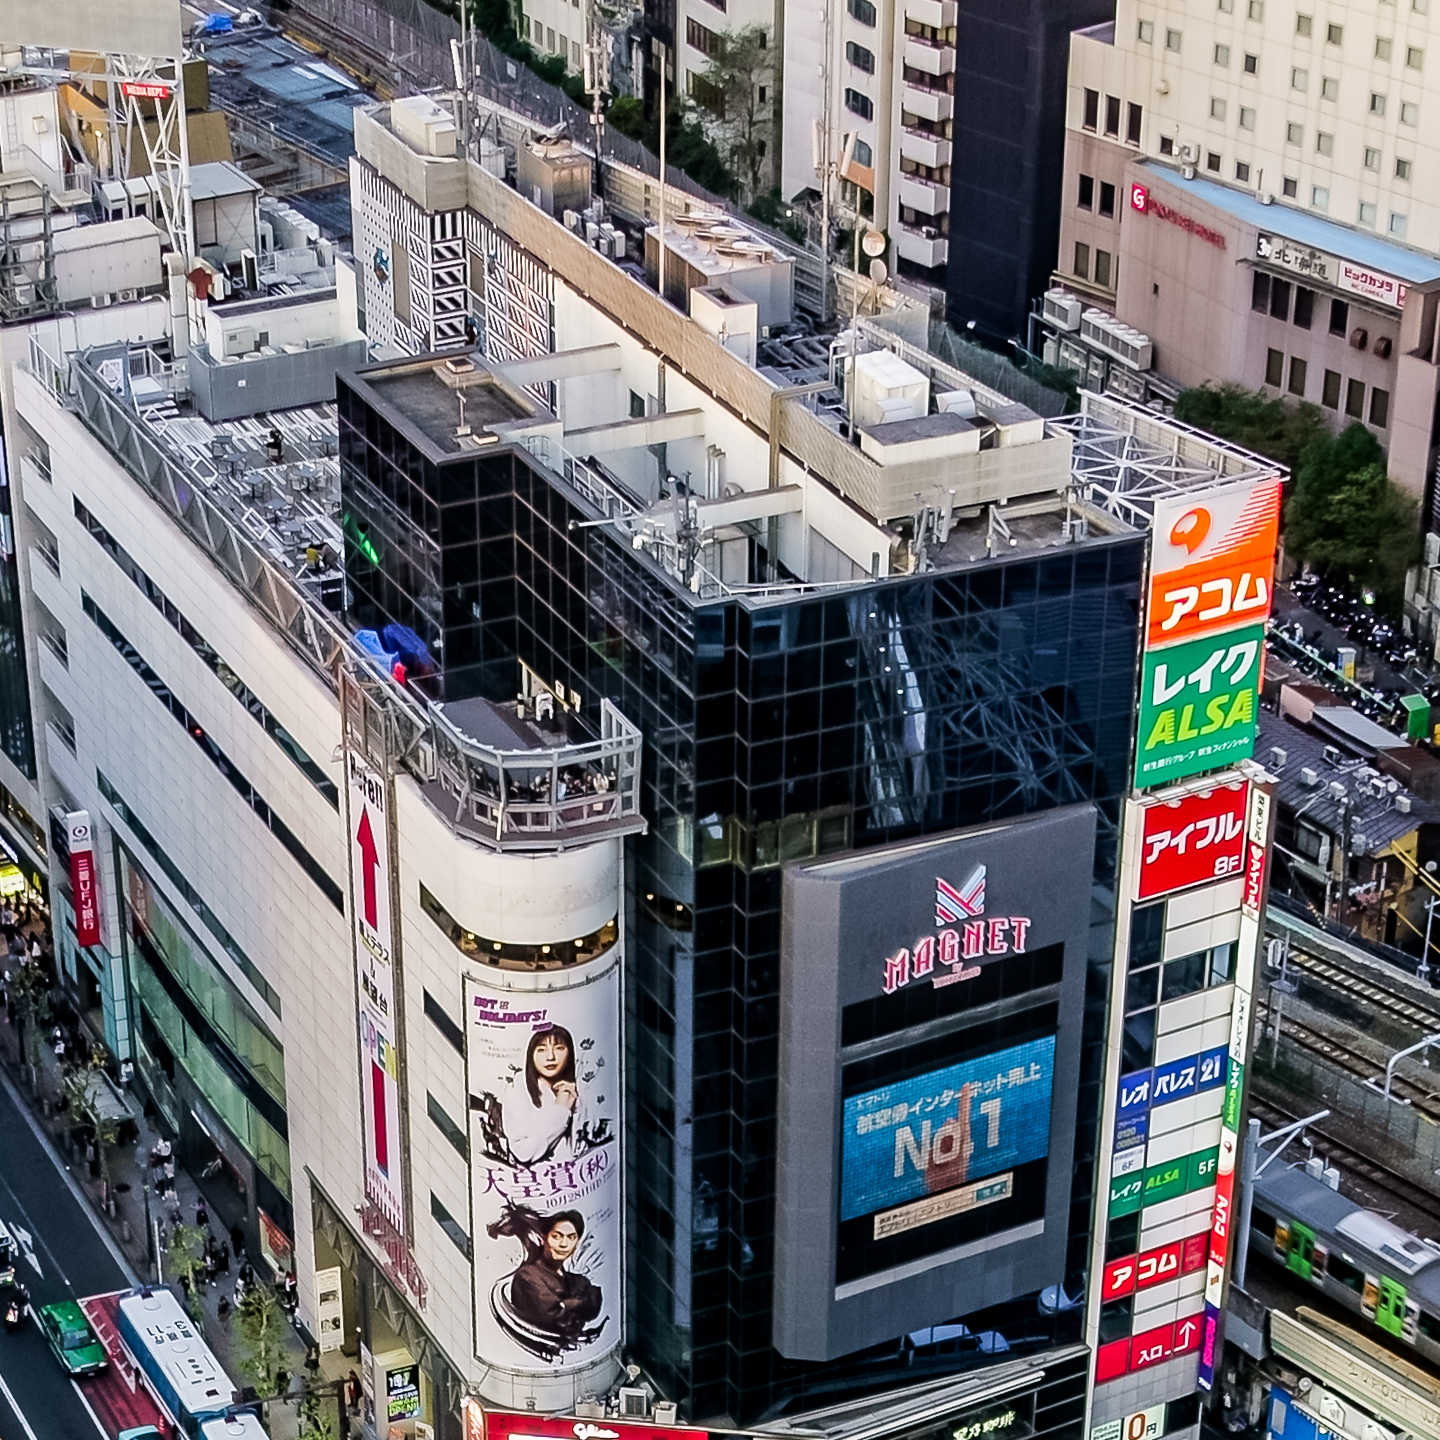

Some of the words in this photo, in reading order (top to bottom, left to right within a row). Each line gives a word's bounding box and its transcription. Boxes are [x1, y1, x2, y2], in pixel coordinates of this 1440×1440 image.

[1163, 573, 1268, 631] アコム
[1152, 639, 1259, 707] レイク
[1145, 689, 1254, 751] ALSA
[1146, 811, 1243, 865] アイフル
[1214, 855, 1240, 875] 8F
[1247, 861, 1261, 909] アイフル
[883, 916, 1032, 995] MAGNET
[482, 1148, 609, 1200] 天皇賞(秋)
[1111, 1181, 1143, 1201] レイク
[1146, 1168, 1180, 1190] ALSA
[1198, 1159, 1216, 1176] 5F
[1122, 1160, 1135, 1172] 6F
[1214, 1194, 1229, 1237] アコム
[1111, 1252, 1178, 1290] アコム
[146, 1320, 186, 1337] 3-11
[1138, 1343, 1163, 1365] 入口
